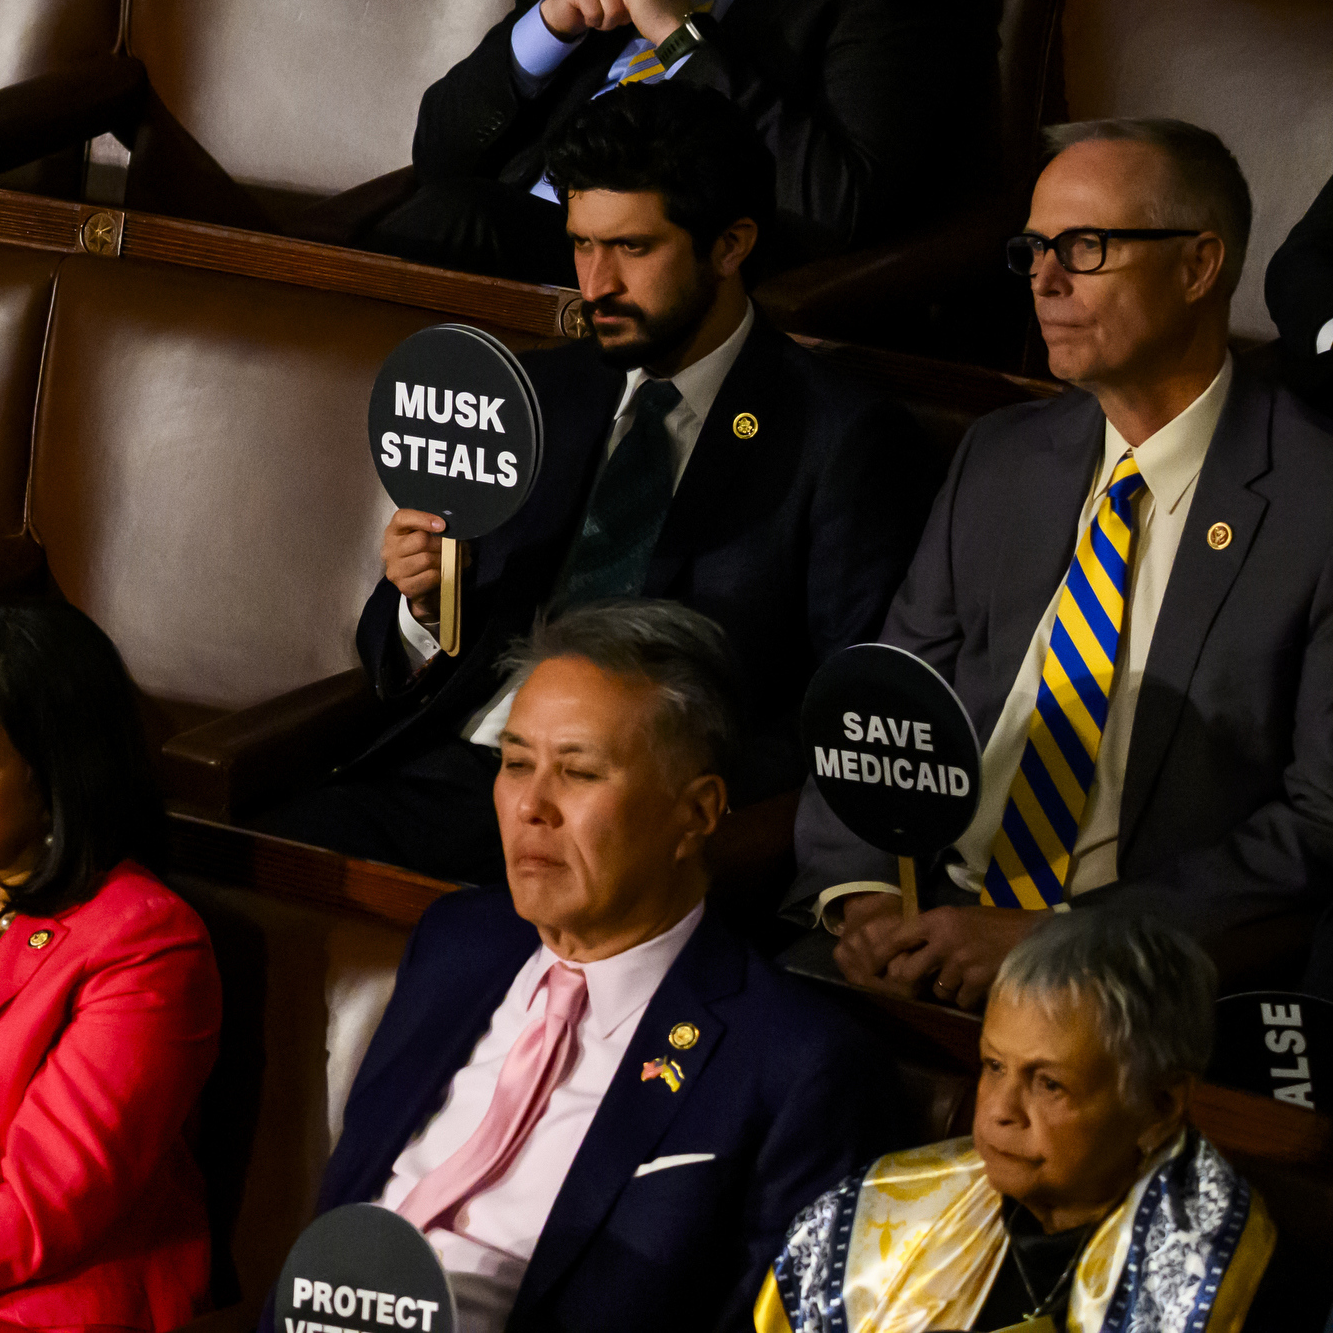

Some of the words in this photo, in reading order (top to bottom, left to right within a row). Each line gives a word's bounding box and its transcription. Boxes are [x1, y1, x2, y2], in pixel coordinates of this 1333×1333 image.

[394, 381, 505, 434] MUSK
[380, 431, 518, 488] STEALS
[842, 711, 935, 752] SAVE
[813, 745, 970, 798] MEDICAID
[1260, 1003, 1316, 1110] ALSE
[292, 1277, 440, 1332] PROTECT
